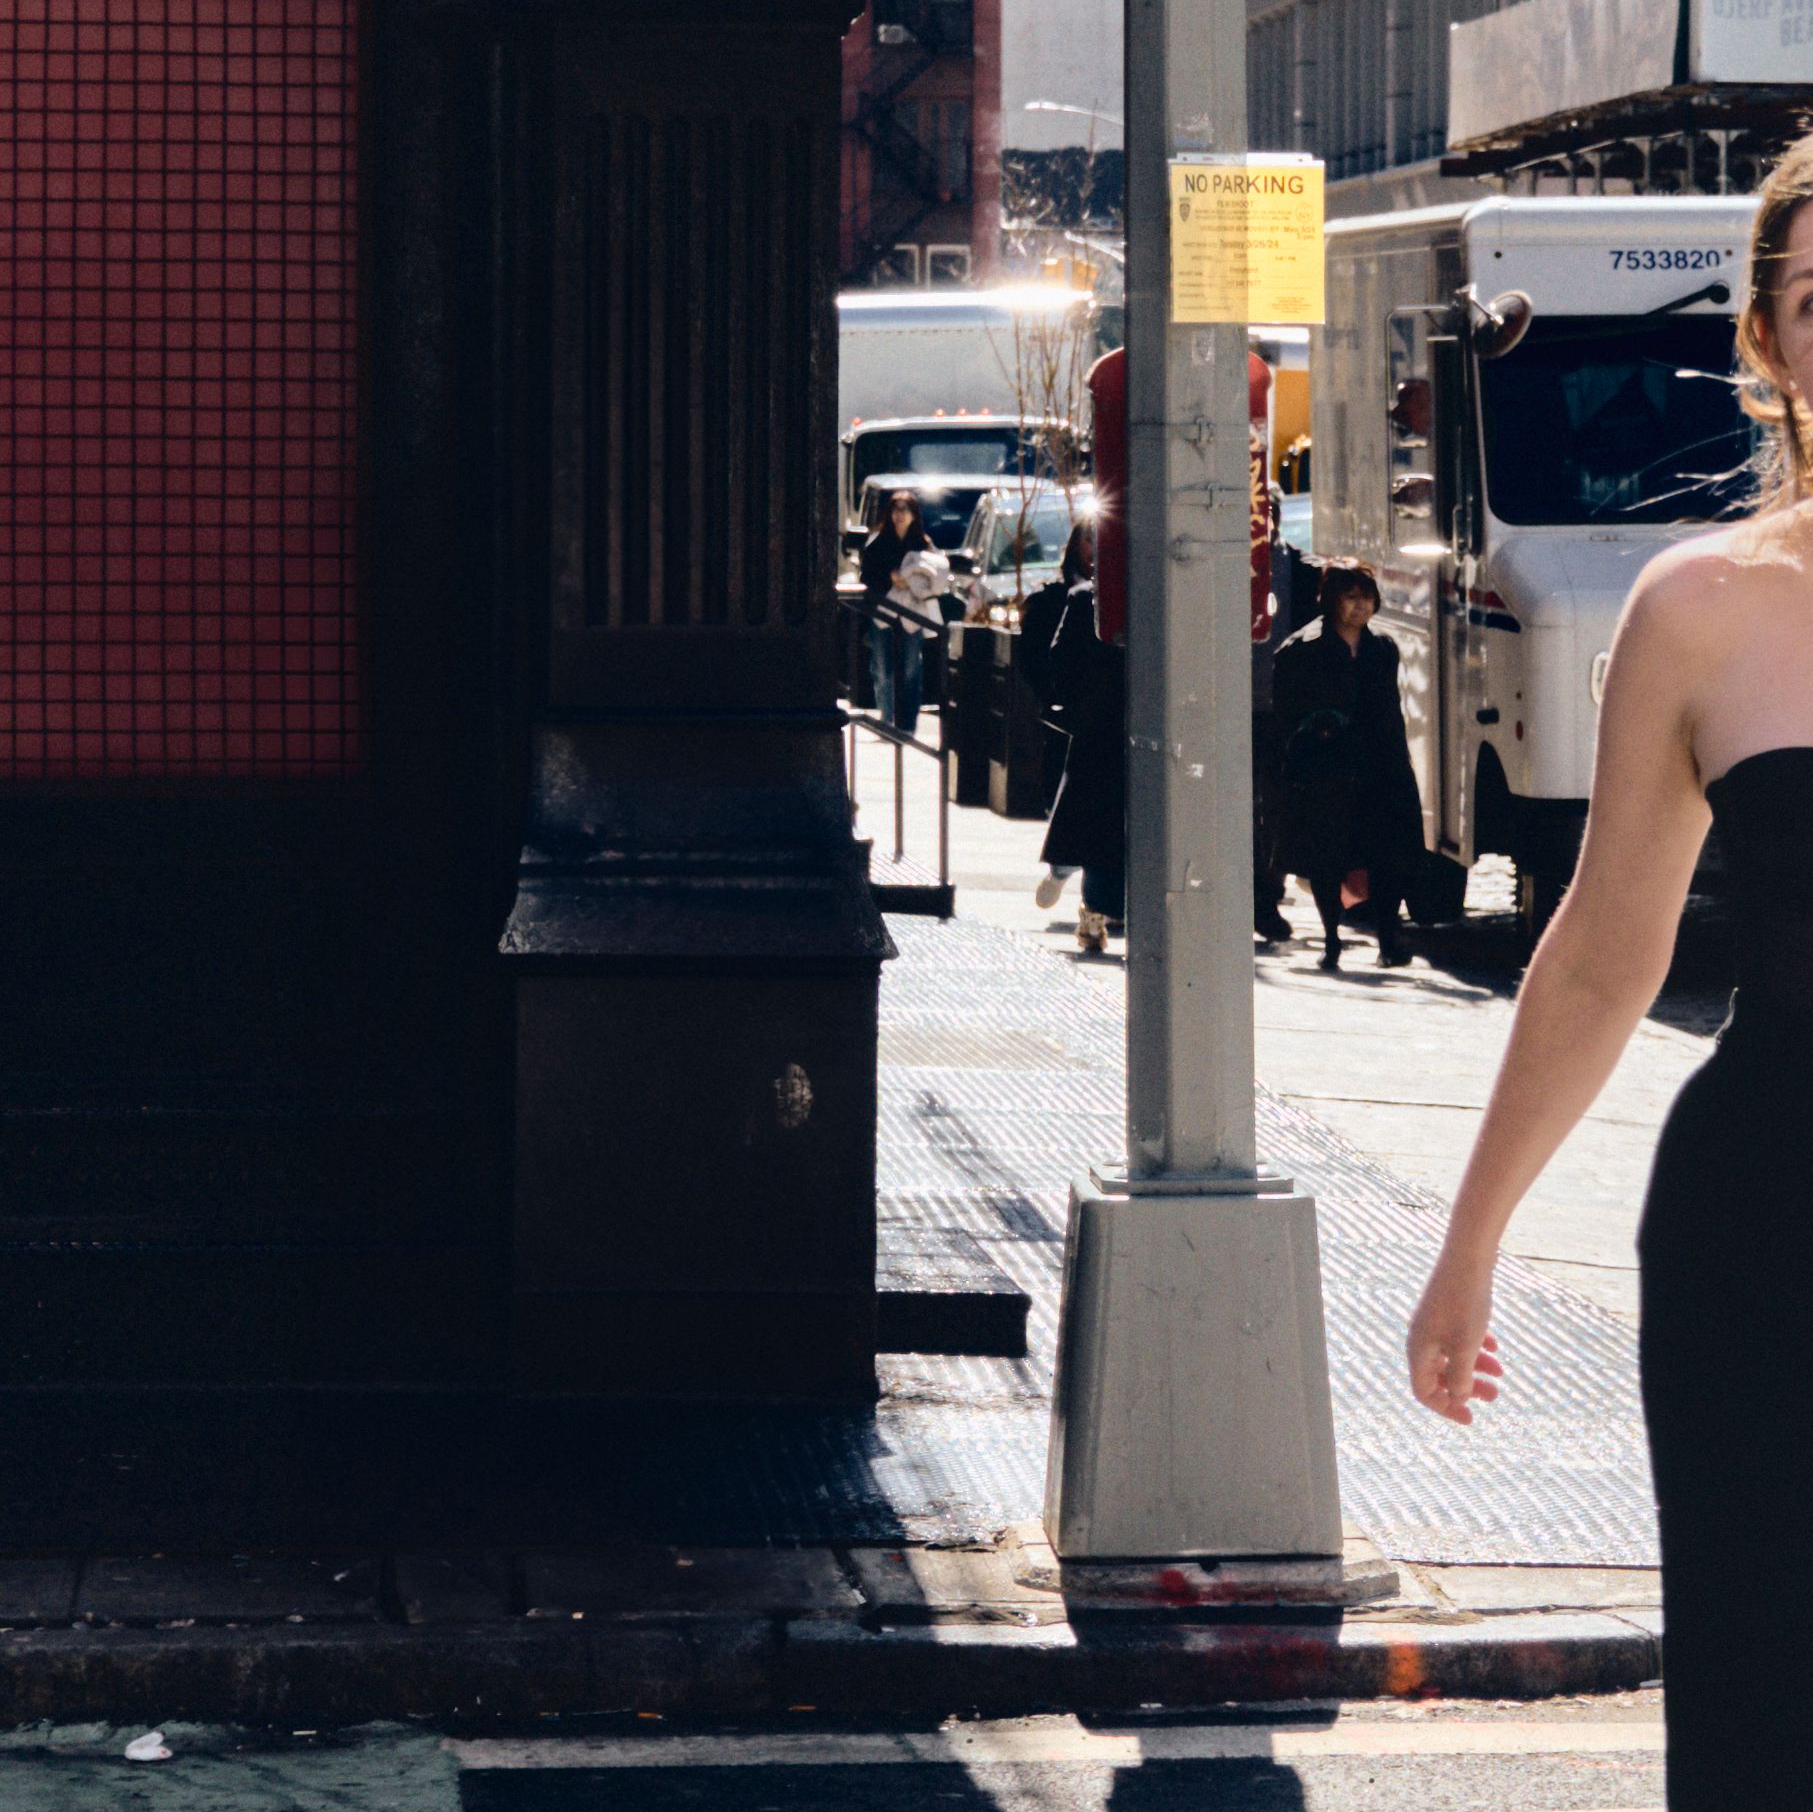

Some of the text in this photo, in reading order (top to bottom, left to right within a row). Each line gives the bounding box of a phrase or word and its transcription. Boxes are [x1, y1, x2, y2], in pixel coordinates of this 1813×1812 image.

[1184, 173, 1304, 195] NO PARKING
[1609, 249, 1720, 270] 7533820
